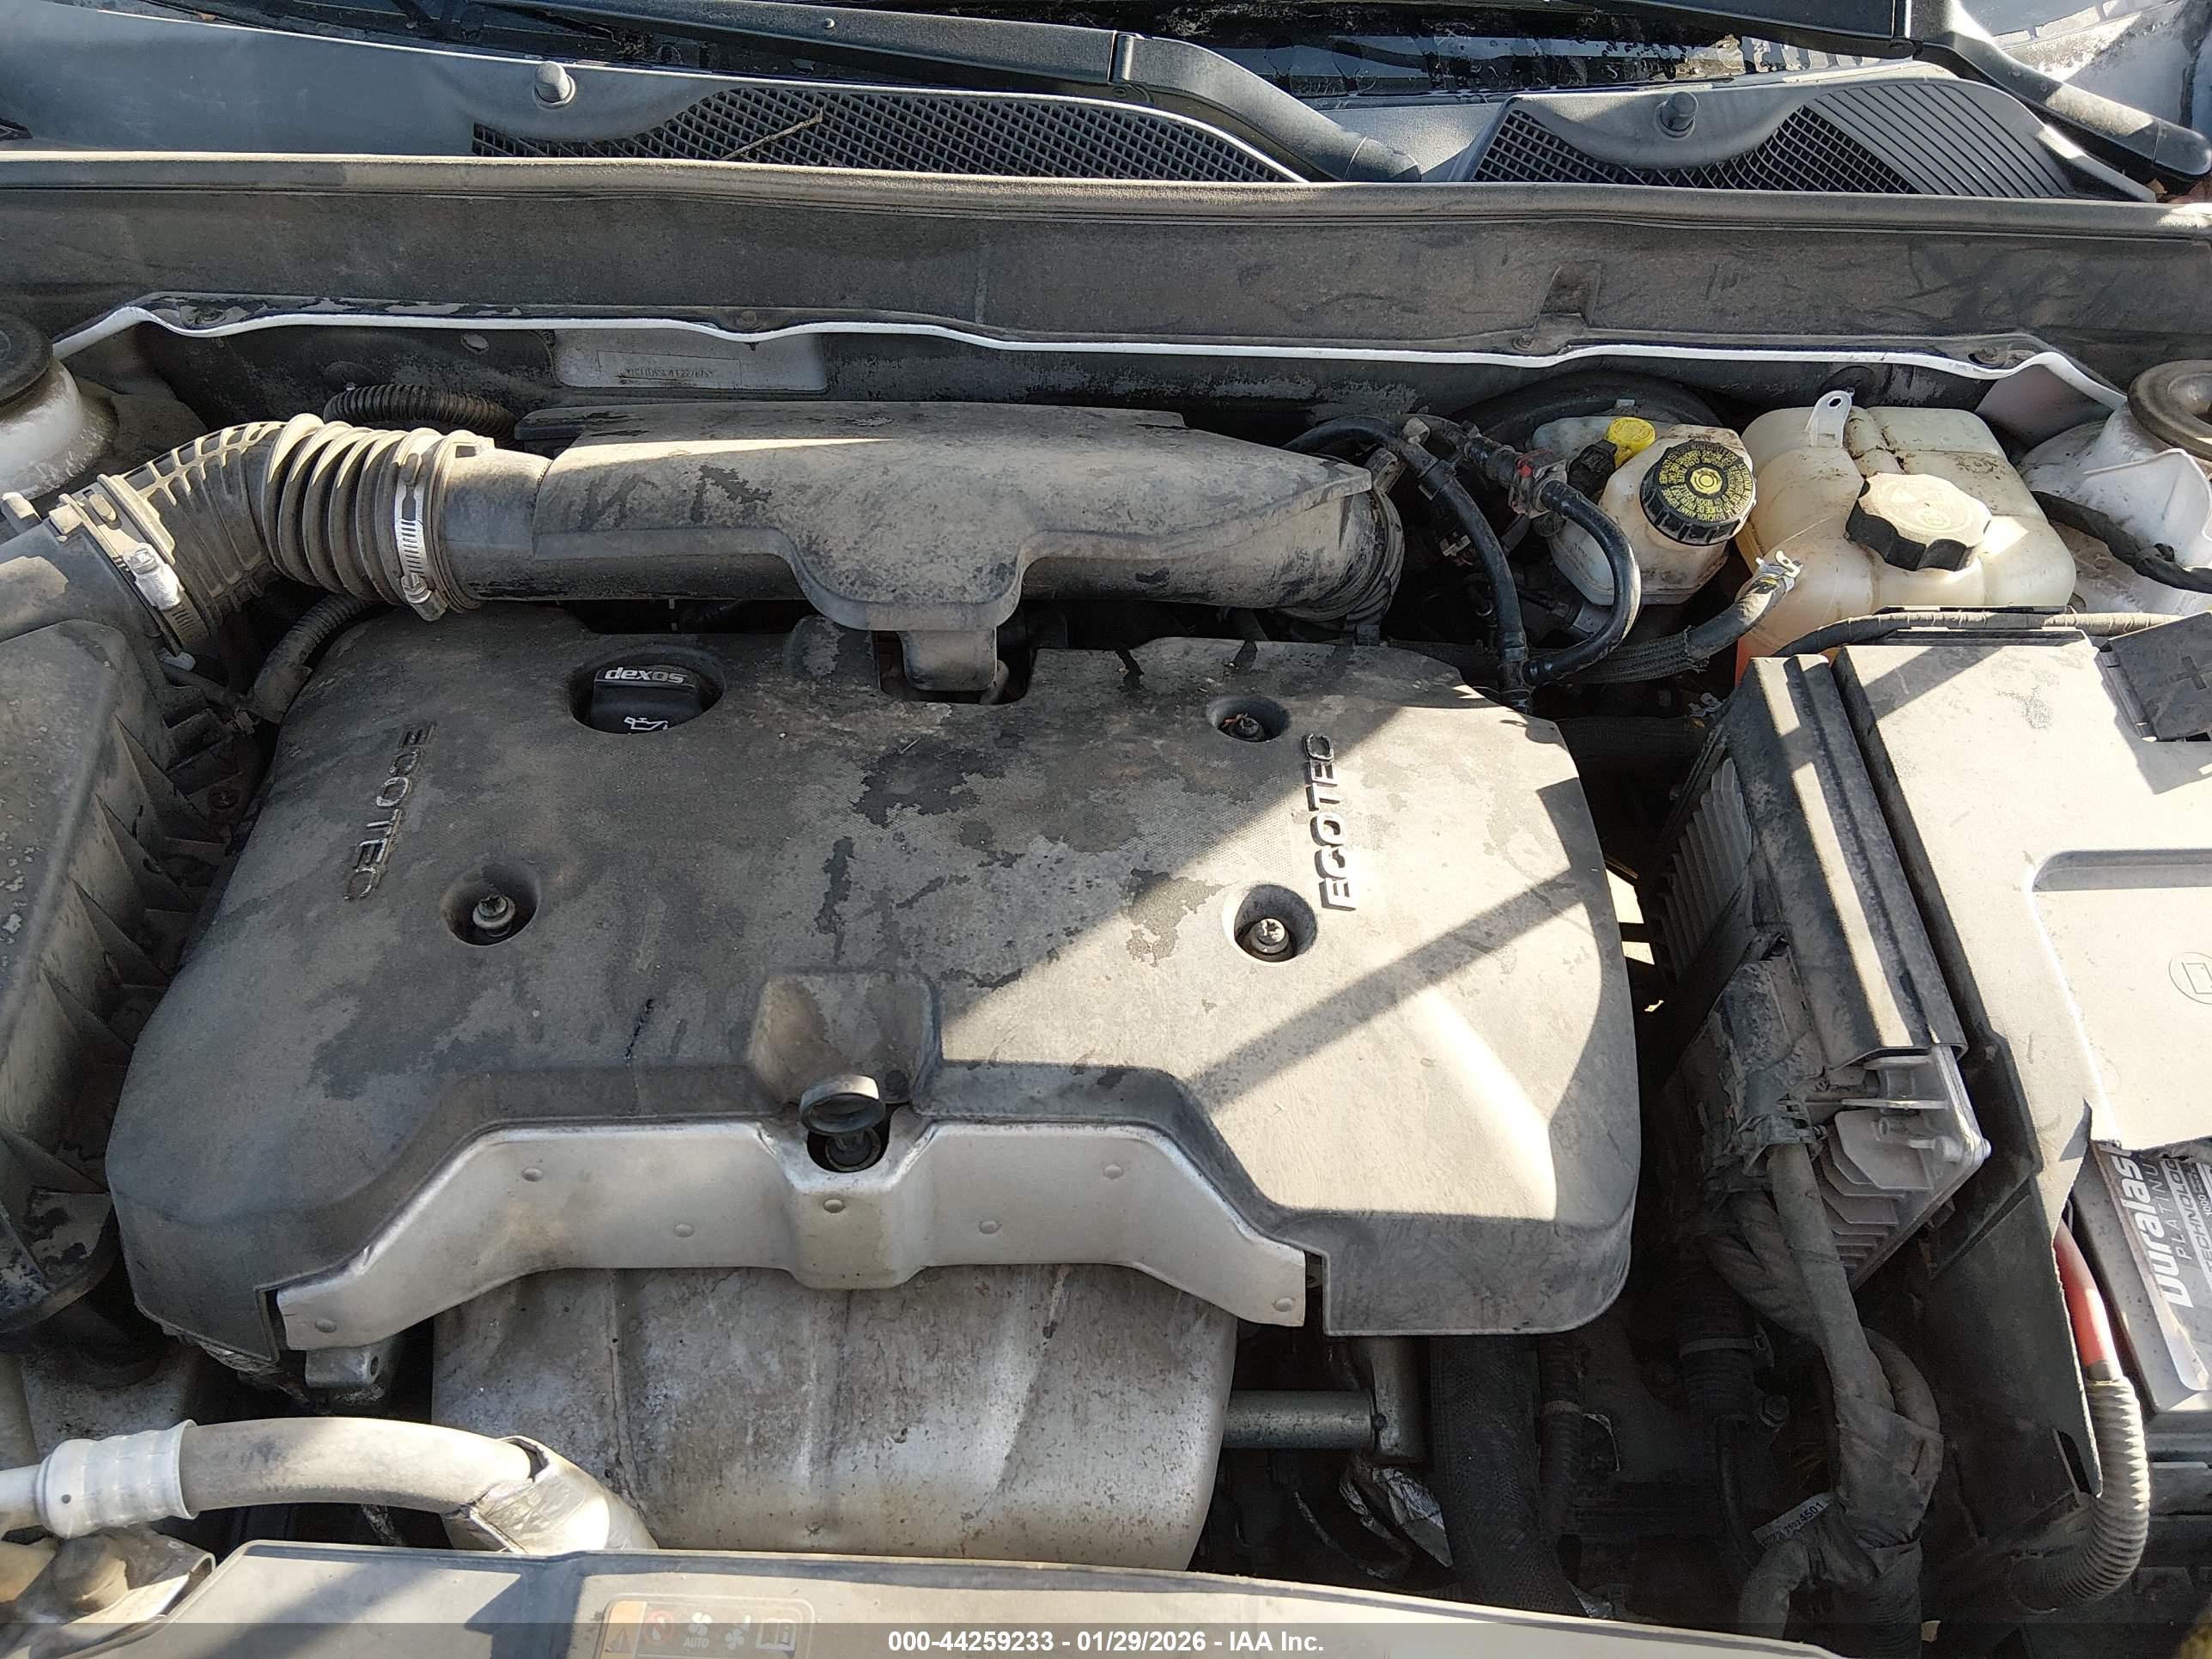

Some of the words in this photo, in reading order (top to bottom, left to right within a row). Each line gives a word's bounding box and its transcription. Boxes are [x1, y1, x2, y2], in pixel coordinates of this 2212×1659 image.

[605, 667, 688, 684] dexos
[343, 720, 435, 901] ECOTEC
[1303, 732, 1357, 911] ECOTEC
[2144, 1161, 2192, 1261] PLATINU
[2162, 1160, 2212, 1273] TECHNOLOG
[683, 1637, 709, 1650] AUTO
